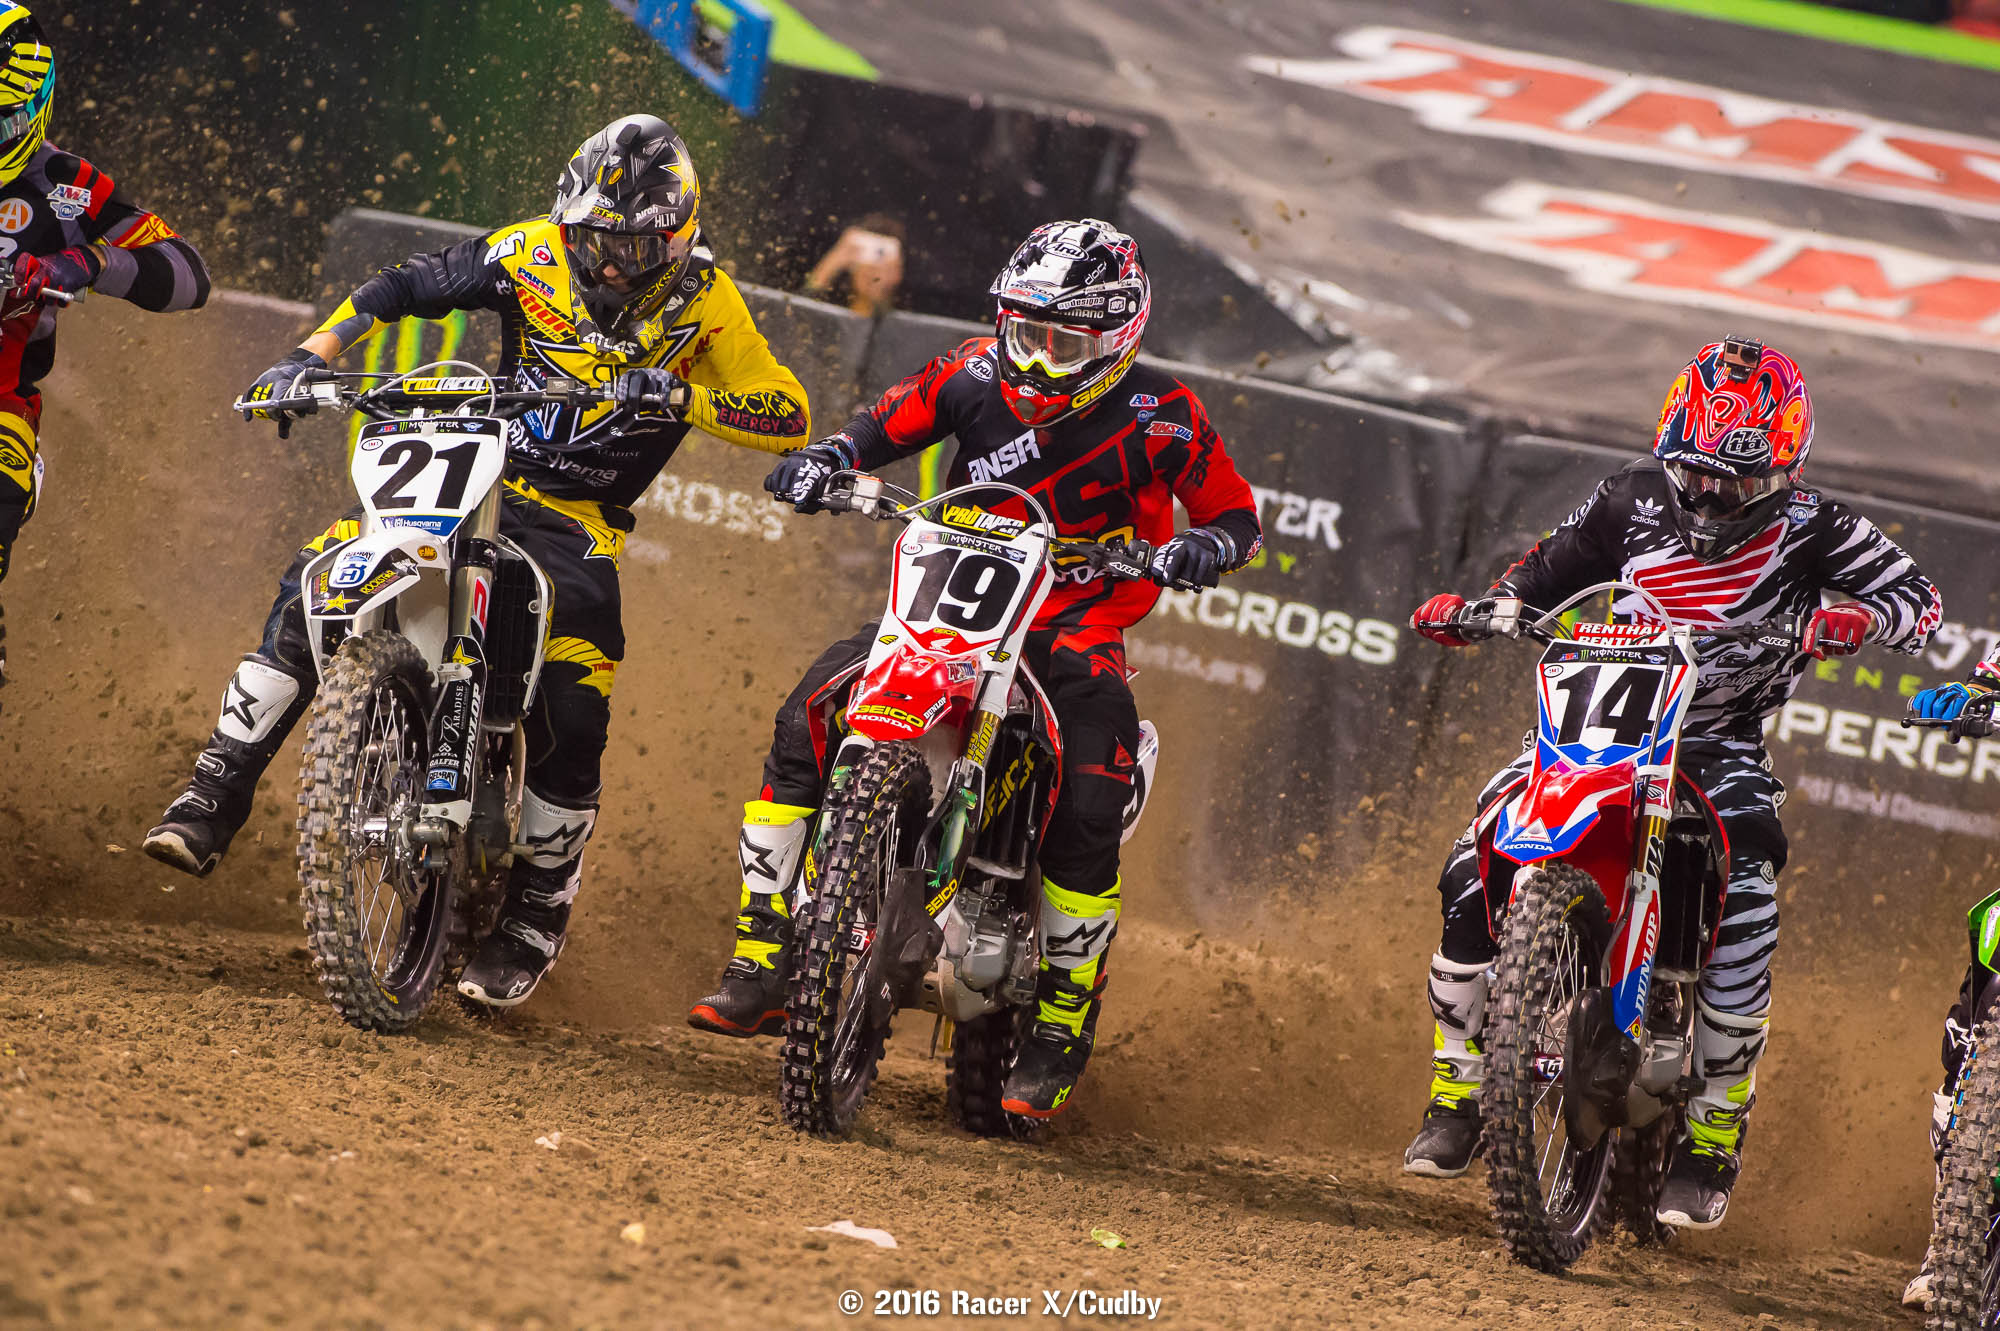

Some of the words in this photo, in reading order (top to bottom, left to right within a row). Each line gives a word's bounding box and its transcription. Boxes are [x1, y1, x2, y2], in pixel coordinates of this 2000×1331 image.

[1046, 242, 1083, 260] Arai
[517, 266, 556, 296] PARTS
[582, 332, 638, 355] ATLAS
[970, 359, 993, 379] Arai
[1071, 347, 1136, 410] GEICO
[1020, 386, 1037, 397] Arai
[719, 407, 780, 433] ENERGY
[1149, 421, 1193, 441] AMSOIL
[968, 429, 1041, 484] ANSR
[1679, 452, 1738, 476] HONDA
[370, 440, 481, 511] 21
[403, 519, 442, 528] Husqvarna
[948, 505, 1026, 535] PROTAPER
[1630, 513, 1660, 527] adidas
[950, 534, 1002, 553] MONSTER
[906, 548, 1021, 632] 19
[934, 628, 958, 637] GEICO
[1759, 635, 1791, 647] ARC
[1590, 648, 1642, 660] MONSTER
[1815, 658, 1922, 697] ENE
[856, 704, 924, 728] GEICO
[923, 695, 947, 719] DUNLOP
[1556, 665, 1665, 747] 14
[463, 682, 481, 778] DUNLOP
[855, 714, 913, 732] HONDA
[1503, 843, 1555, 853] HONDA
[1635, 911, 1659, 1015] DUNLOP
